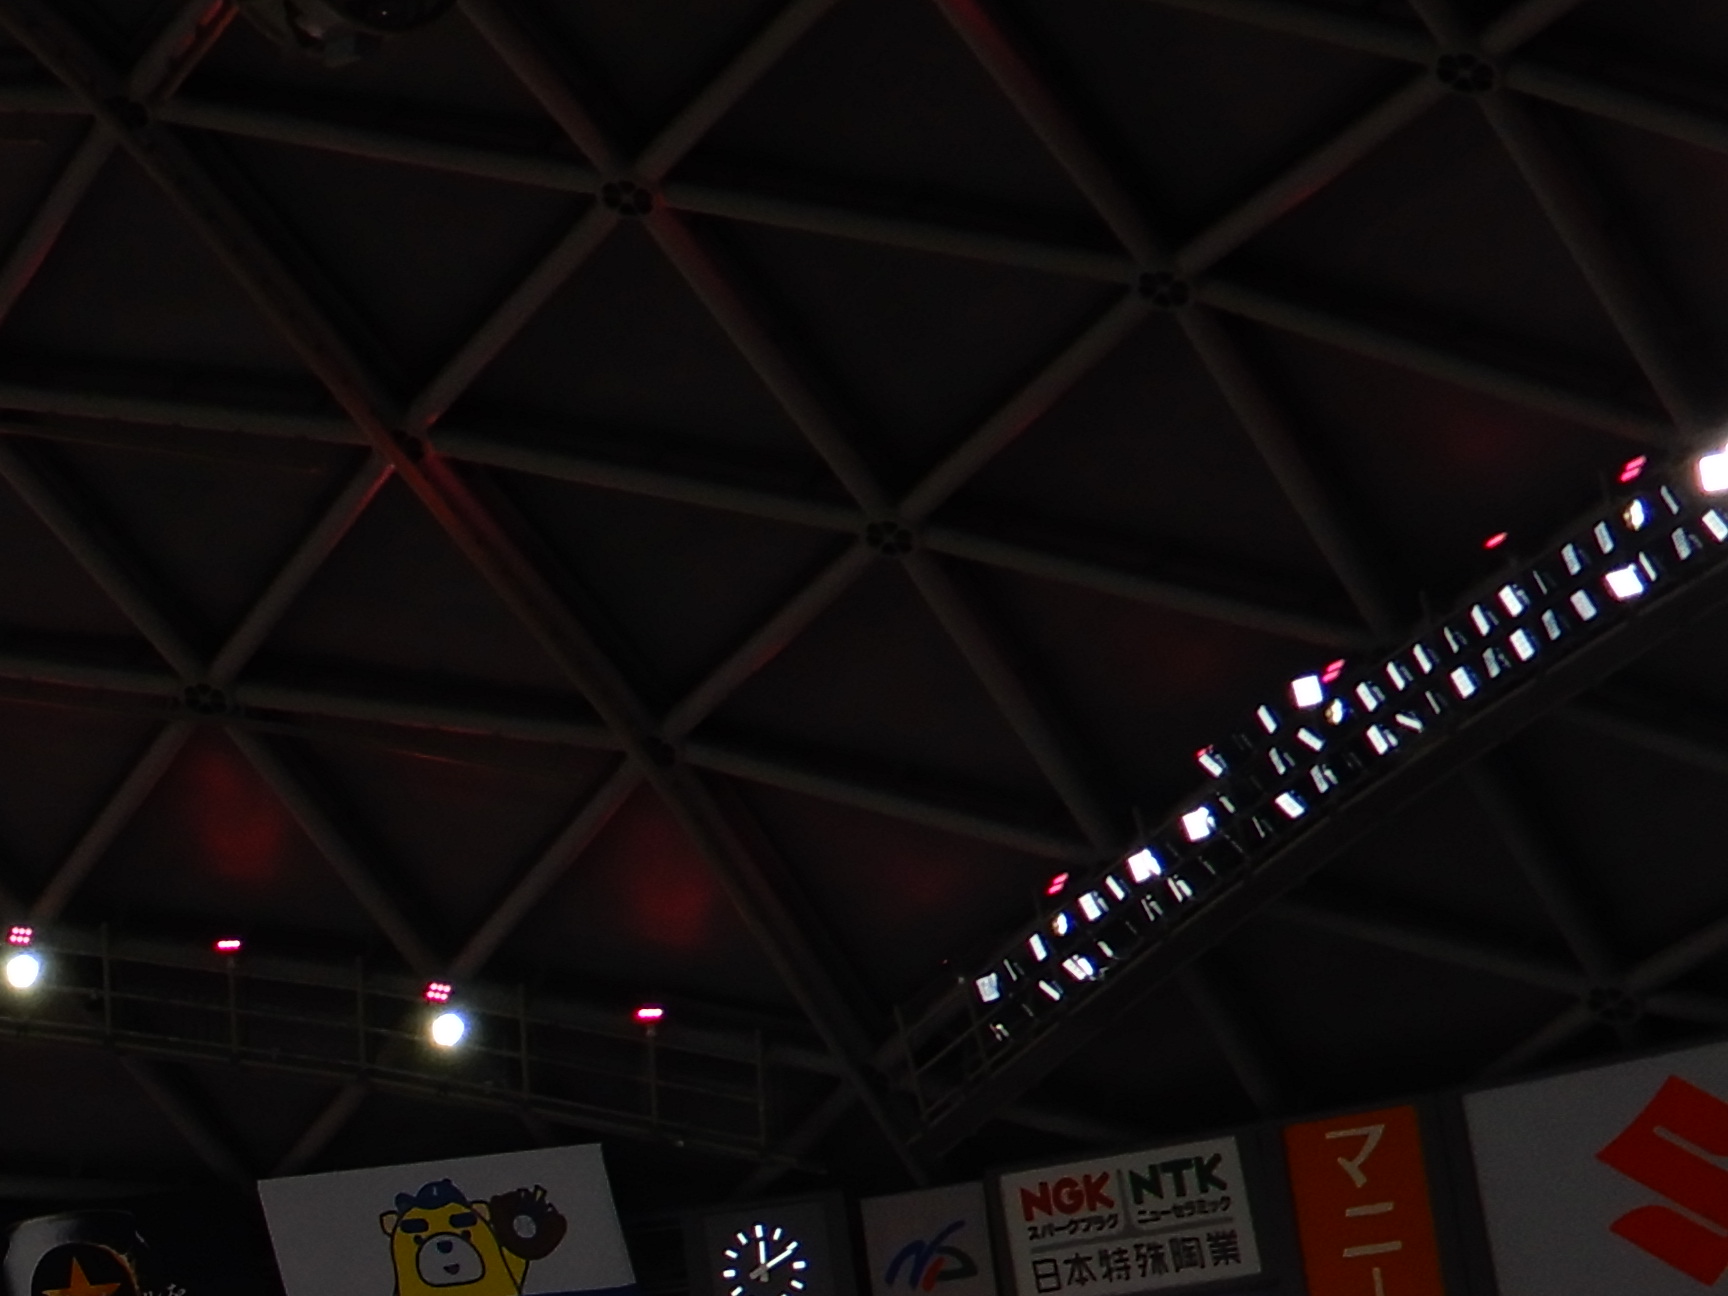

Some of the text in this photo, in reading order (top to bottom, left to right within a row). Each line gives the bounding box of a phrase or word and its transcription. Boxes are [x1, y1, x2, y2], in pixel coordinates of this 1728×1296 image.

[1020, 1171, 1116, 1223] NGK
[1128, 1152, 1229, 1204] NTK
[1032, 1229, 1243, 1295] 日本特殊陶業
